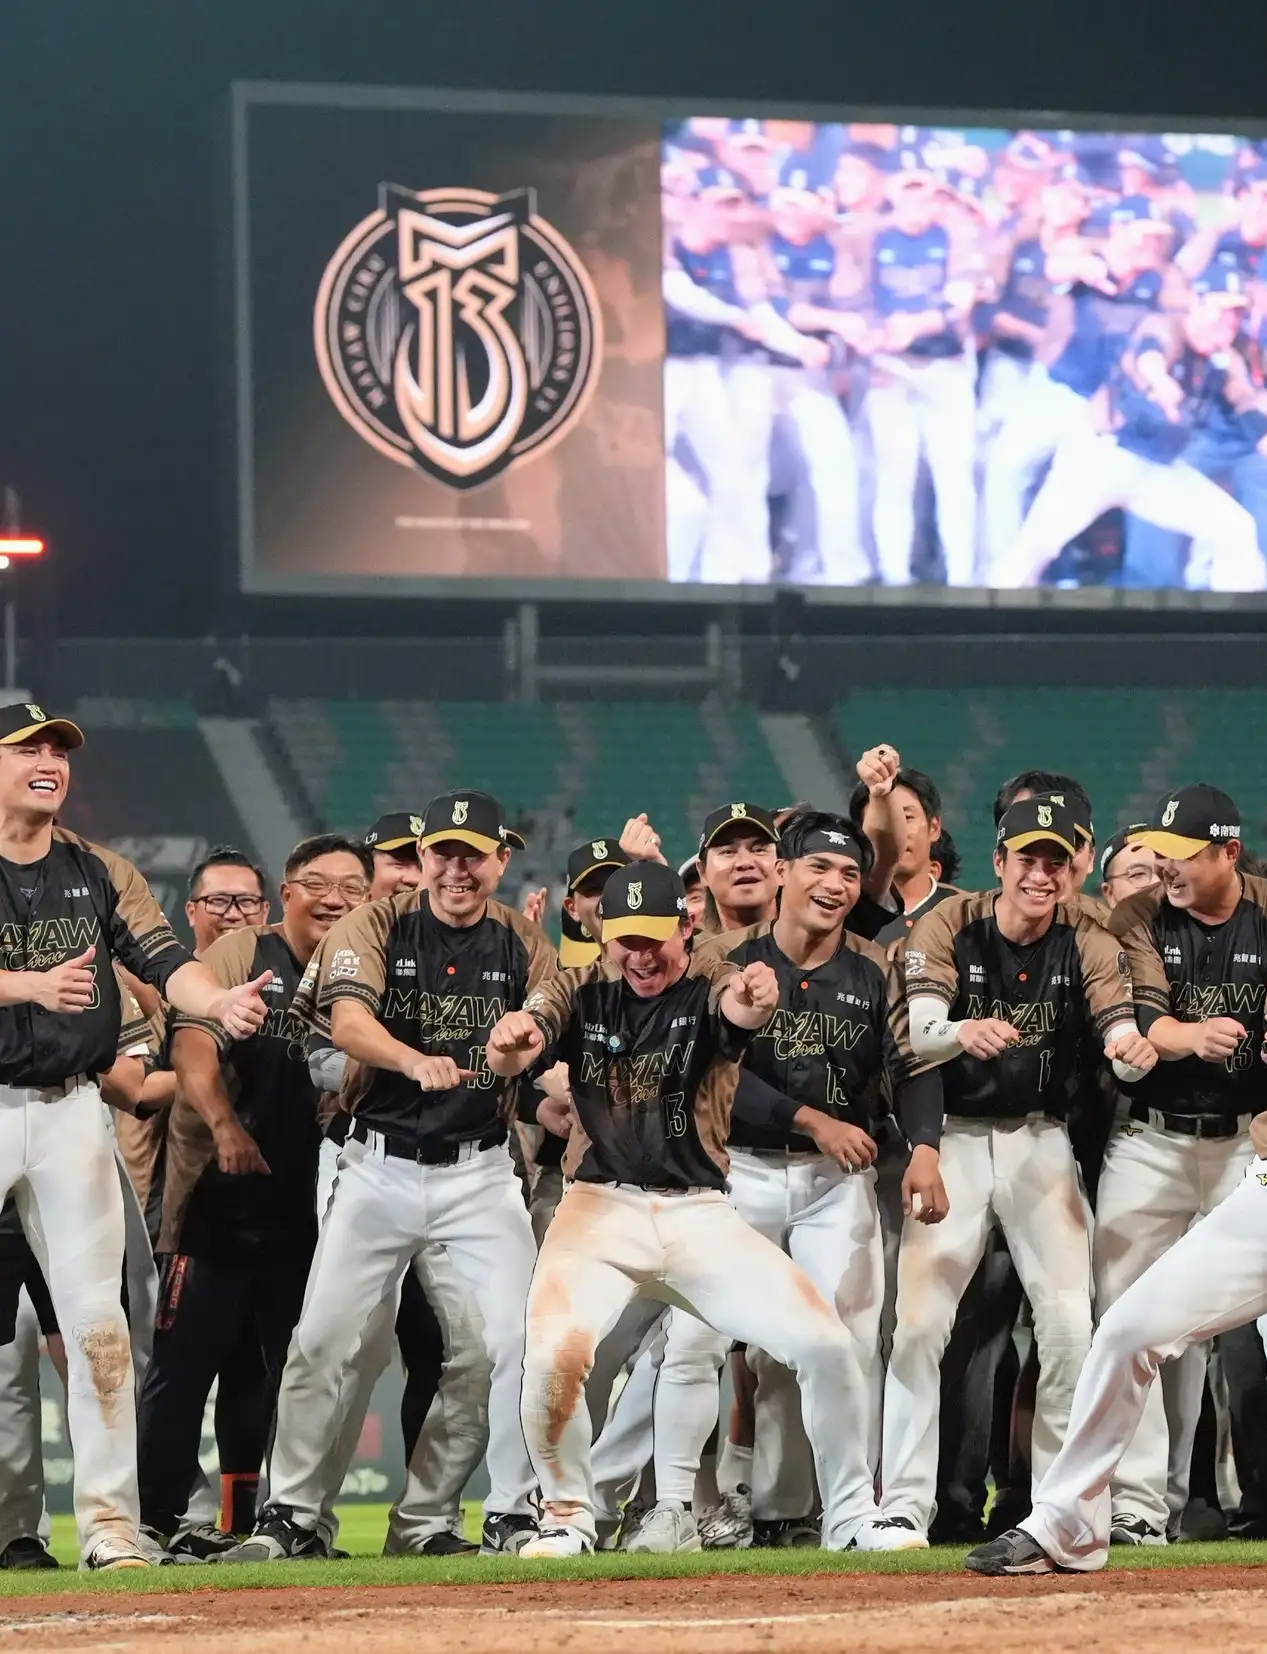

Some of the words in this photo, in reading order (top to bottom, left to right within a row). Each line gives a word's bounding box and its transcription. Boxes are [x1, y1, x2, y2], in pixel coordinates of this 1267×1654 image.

[0, 917, 101, 952] AYAW
[756, 1009, 868, 1051] AYAW
[661, 1091, 687, 1139] 13
